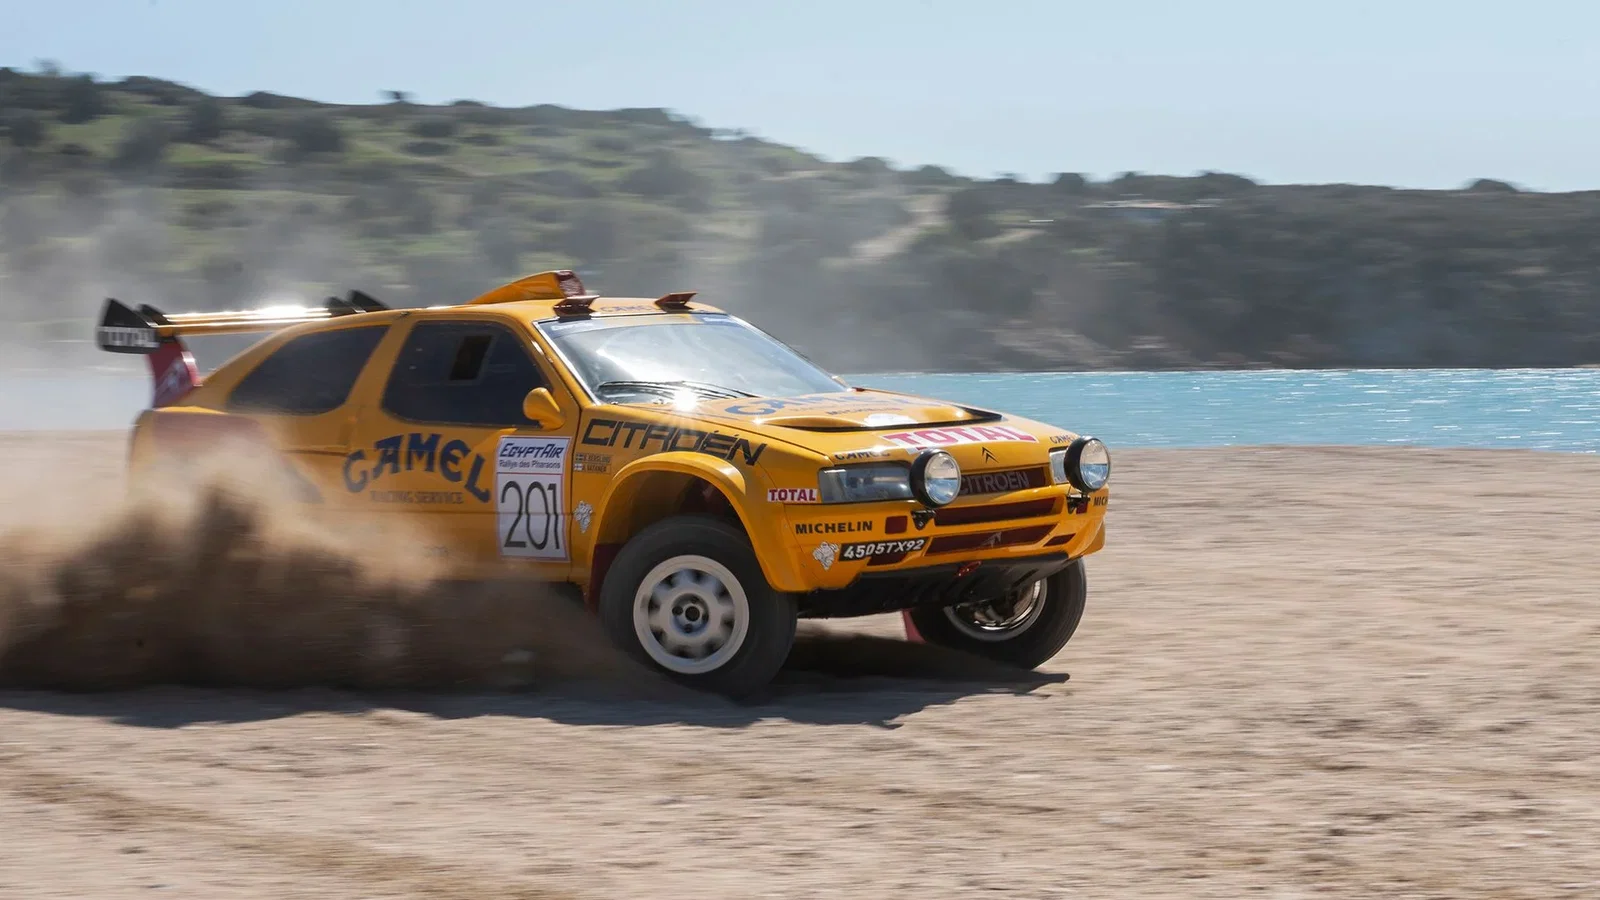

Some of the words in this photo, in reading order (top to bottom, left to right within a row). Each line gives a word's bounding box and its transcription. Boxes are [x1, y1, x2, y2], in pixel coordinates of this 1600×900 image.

[884, 426, 1037, 449] TOTAL
[343, 433, 491, 503] CAMEL
[499, 460, 518, 469] Rallye
[520, 460, 530, 468] des
[532, 460, 561, 469] Pharaons
[959, 471, 1030, 494] CITROEN
[415, 491, 464, 504] SERVICE
[768, 489, 816, 501] TOTAL
[501, 481, 560, 550] 201
[795, 521, 873, 534] MICHELIN
[843, 539, 925, 559] 4505TX92
